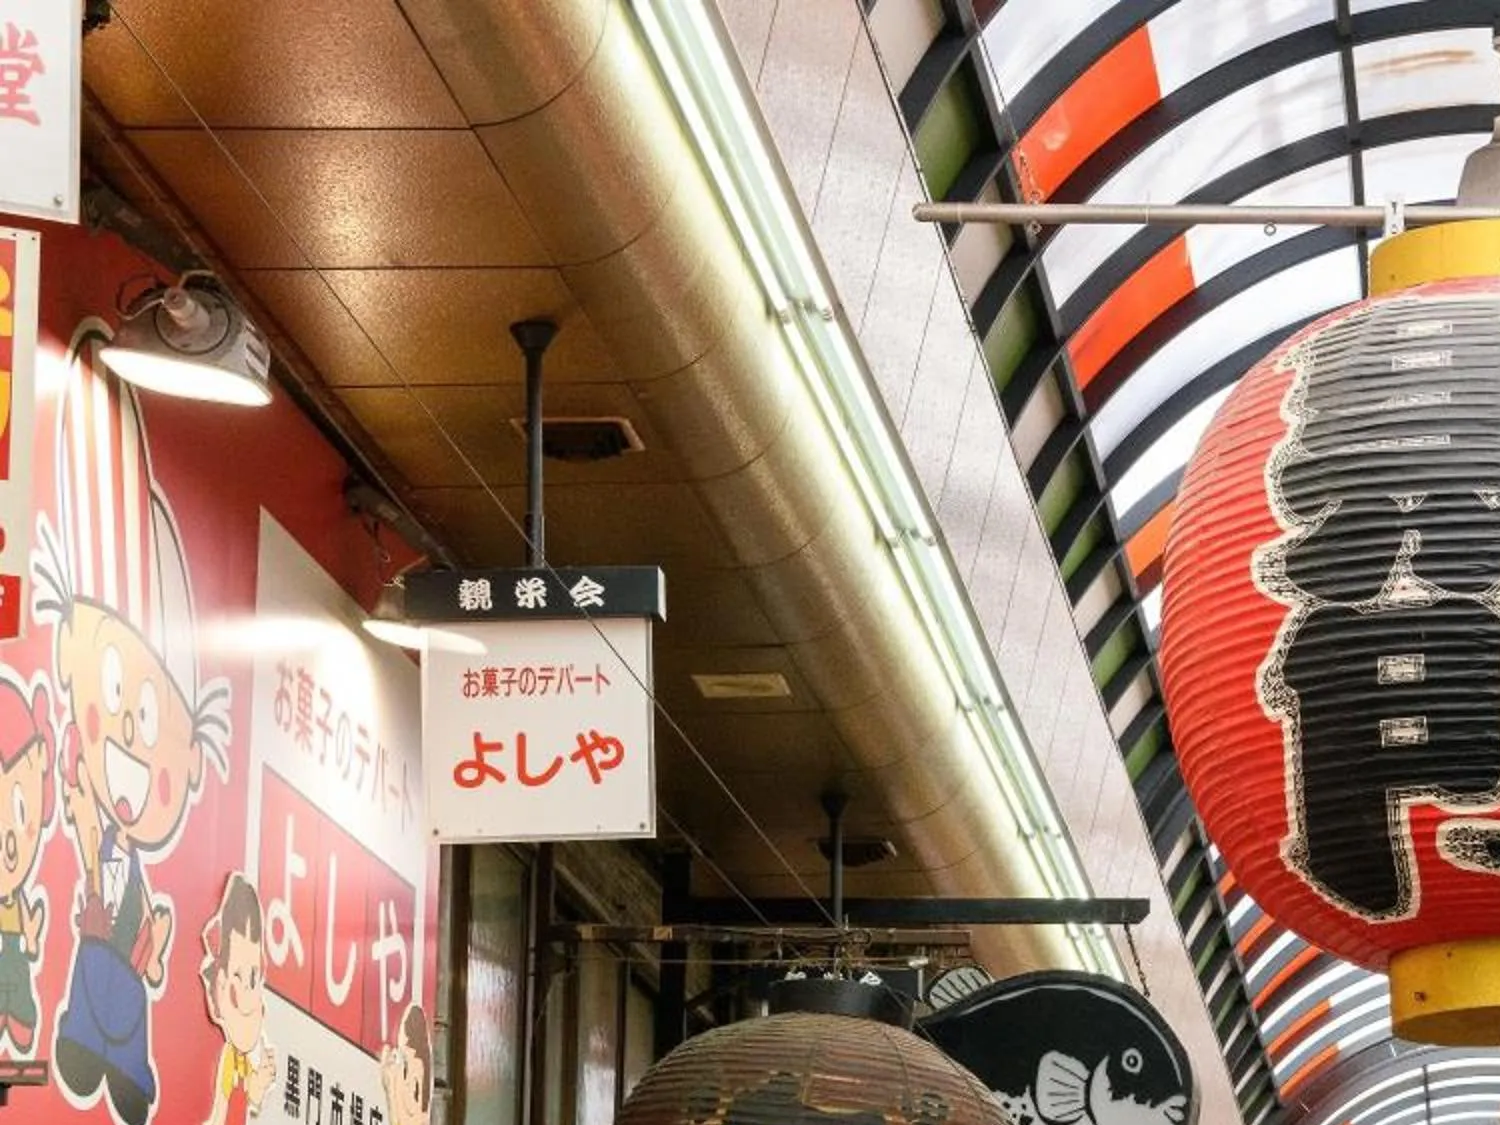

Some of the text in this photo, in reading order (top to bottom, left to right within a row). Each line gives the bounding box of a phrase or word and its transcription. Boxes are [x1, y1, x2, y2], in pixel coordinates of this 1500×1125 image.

[462, 663, 611, 699] お菓子のデパート
[452, 730, 625, 788] よしや
[264, 815, 410, 1042] よしや
